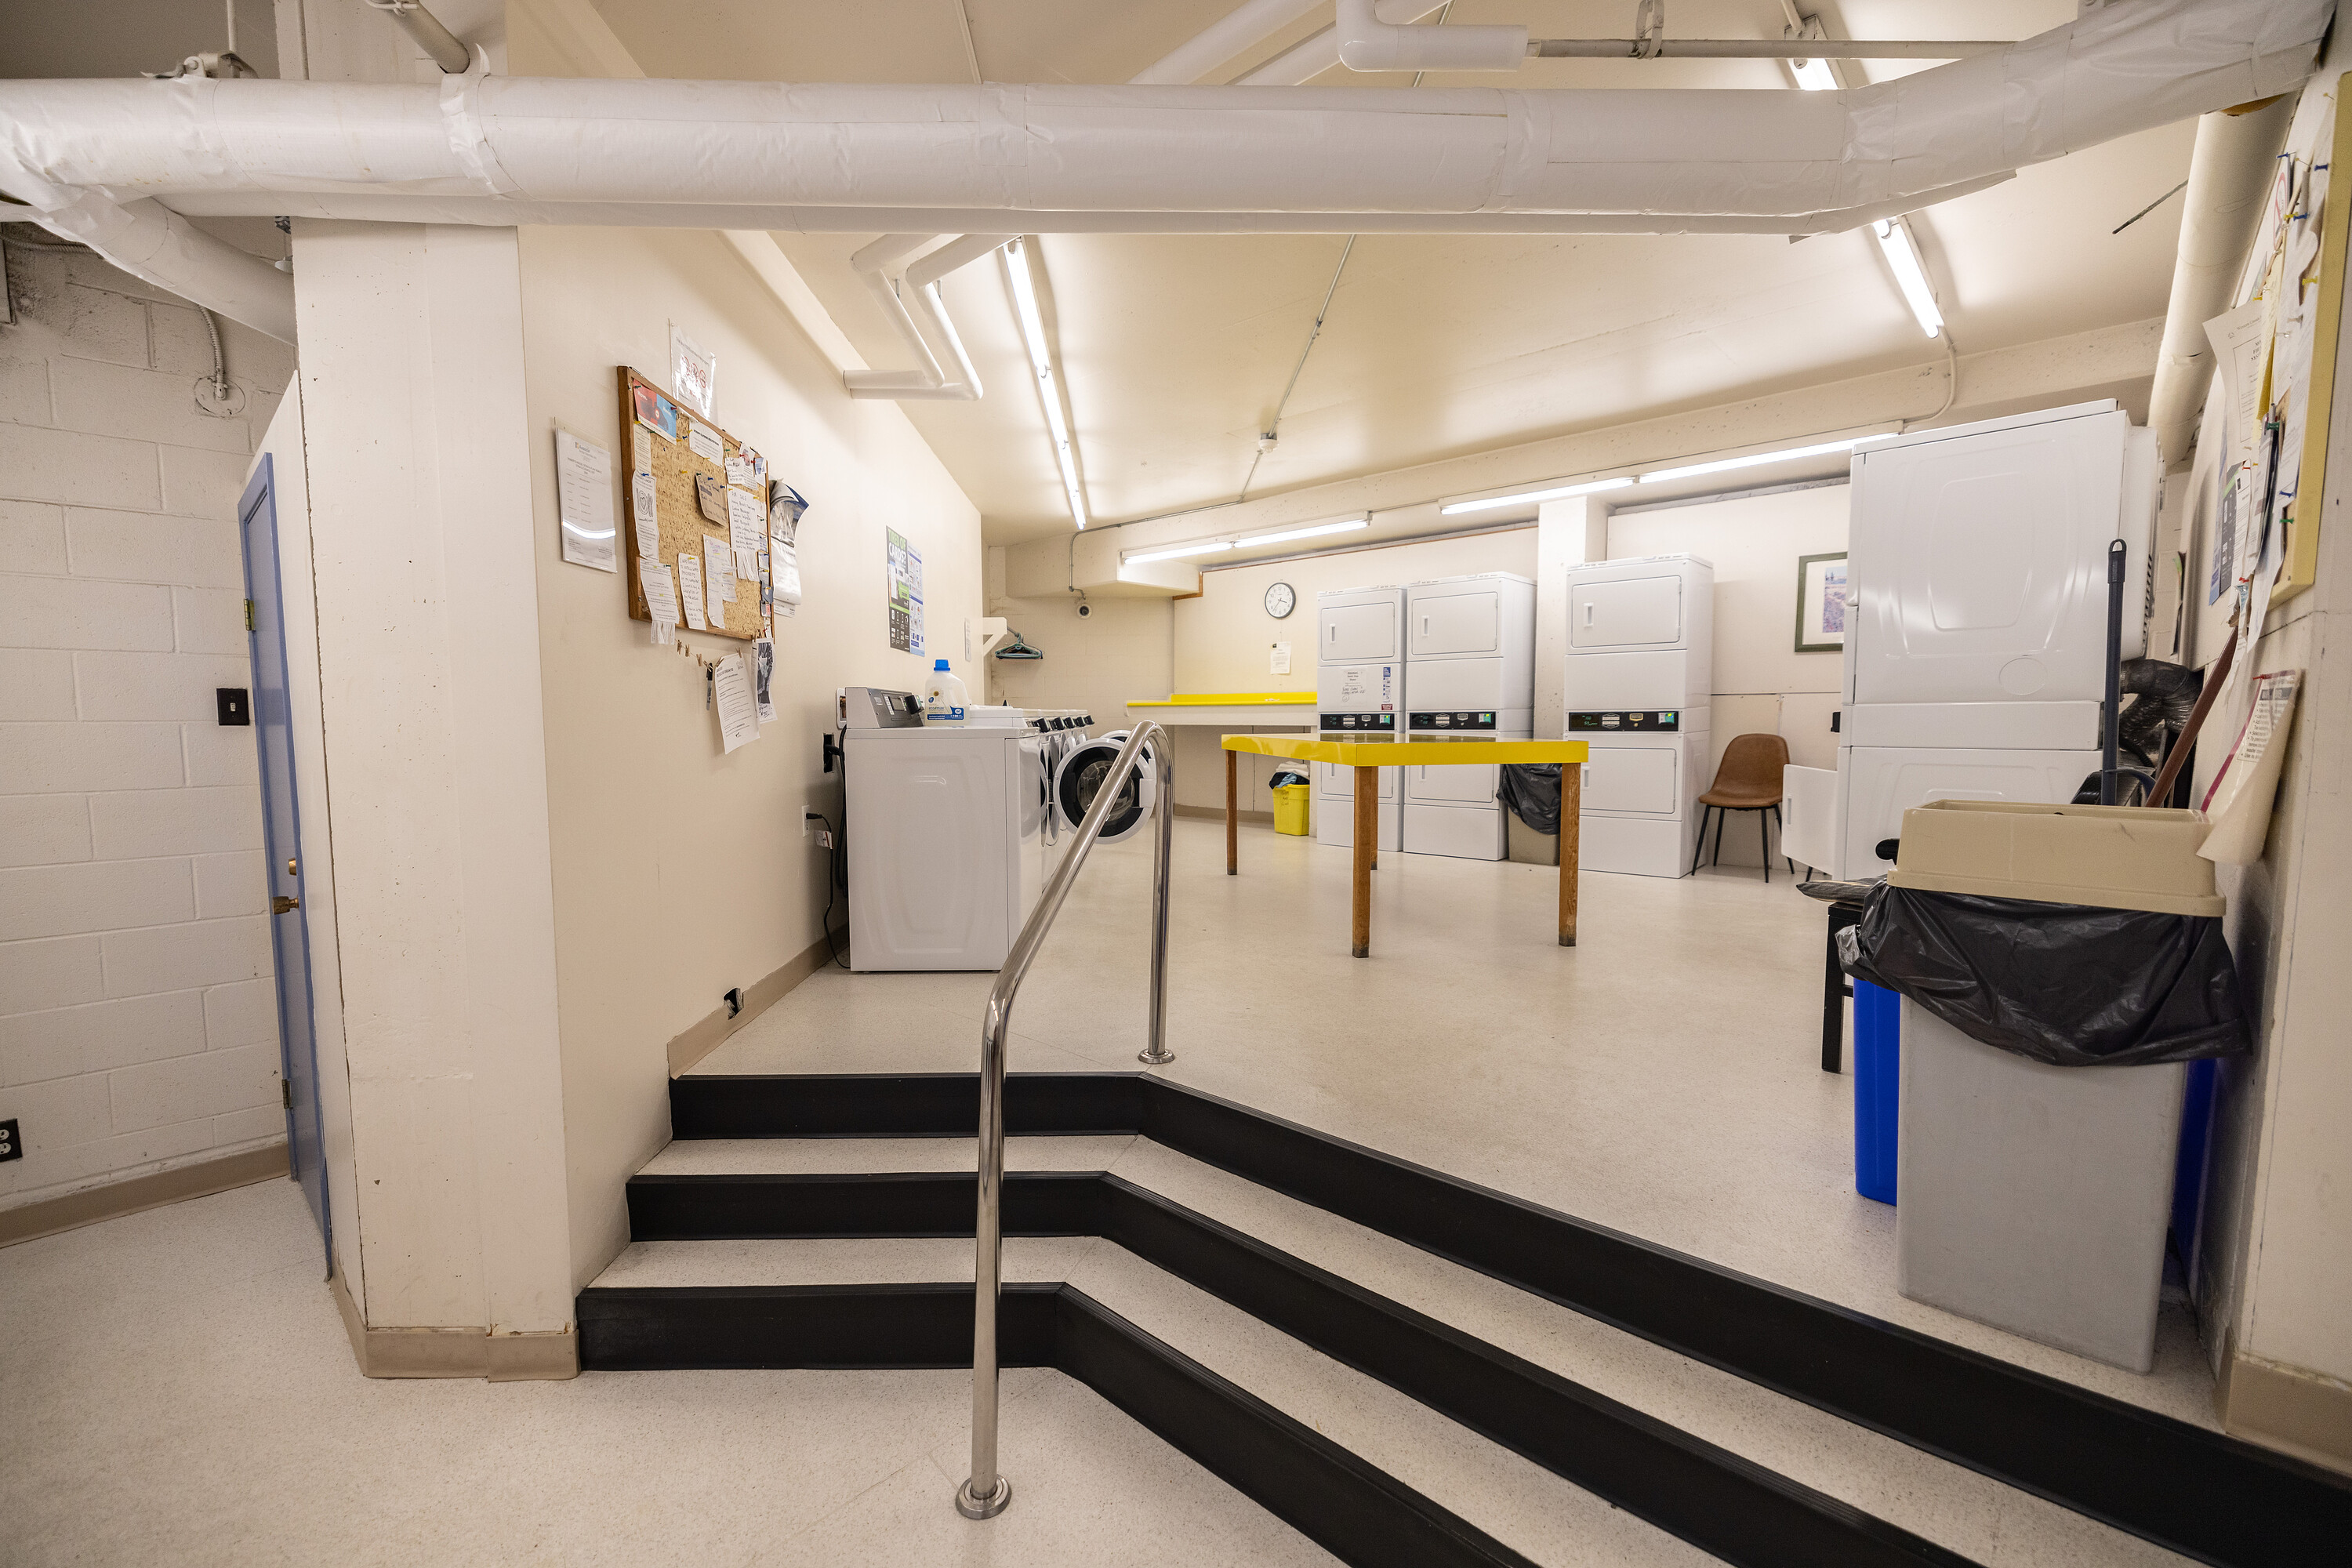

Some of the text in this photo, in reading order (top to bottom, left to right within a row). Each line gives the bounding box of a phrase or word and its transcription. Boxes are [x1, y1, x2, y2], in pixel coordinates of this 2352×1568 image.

[887, 528, 907, 551] TIRED OF
[888, 542, 907, 564] CARDS?
